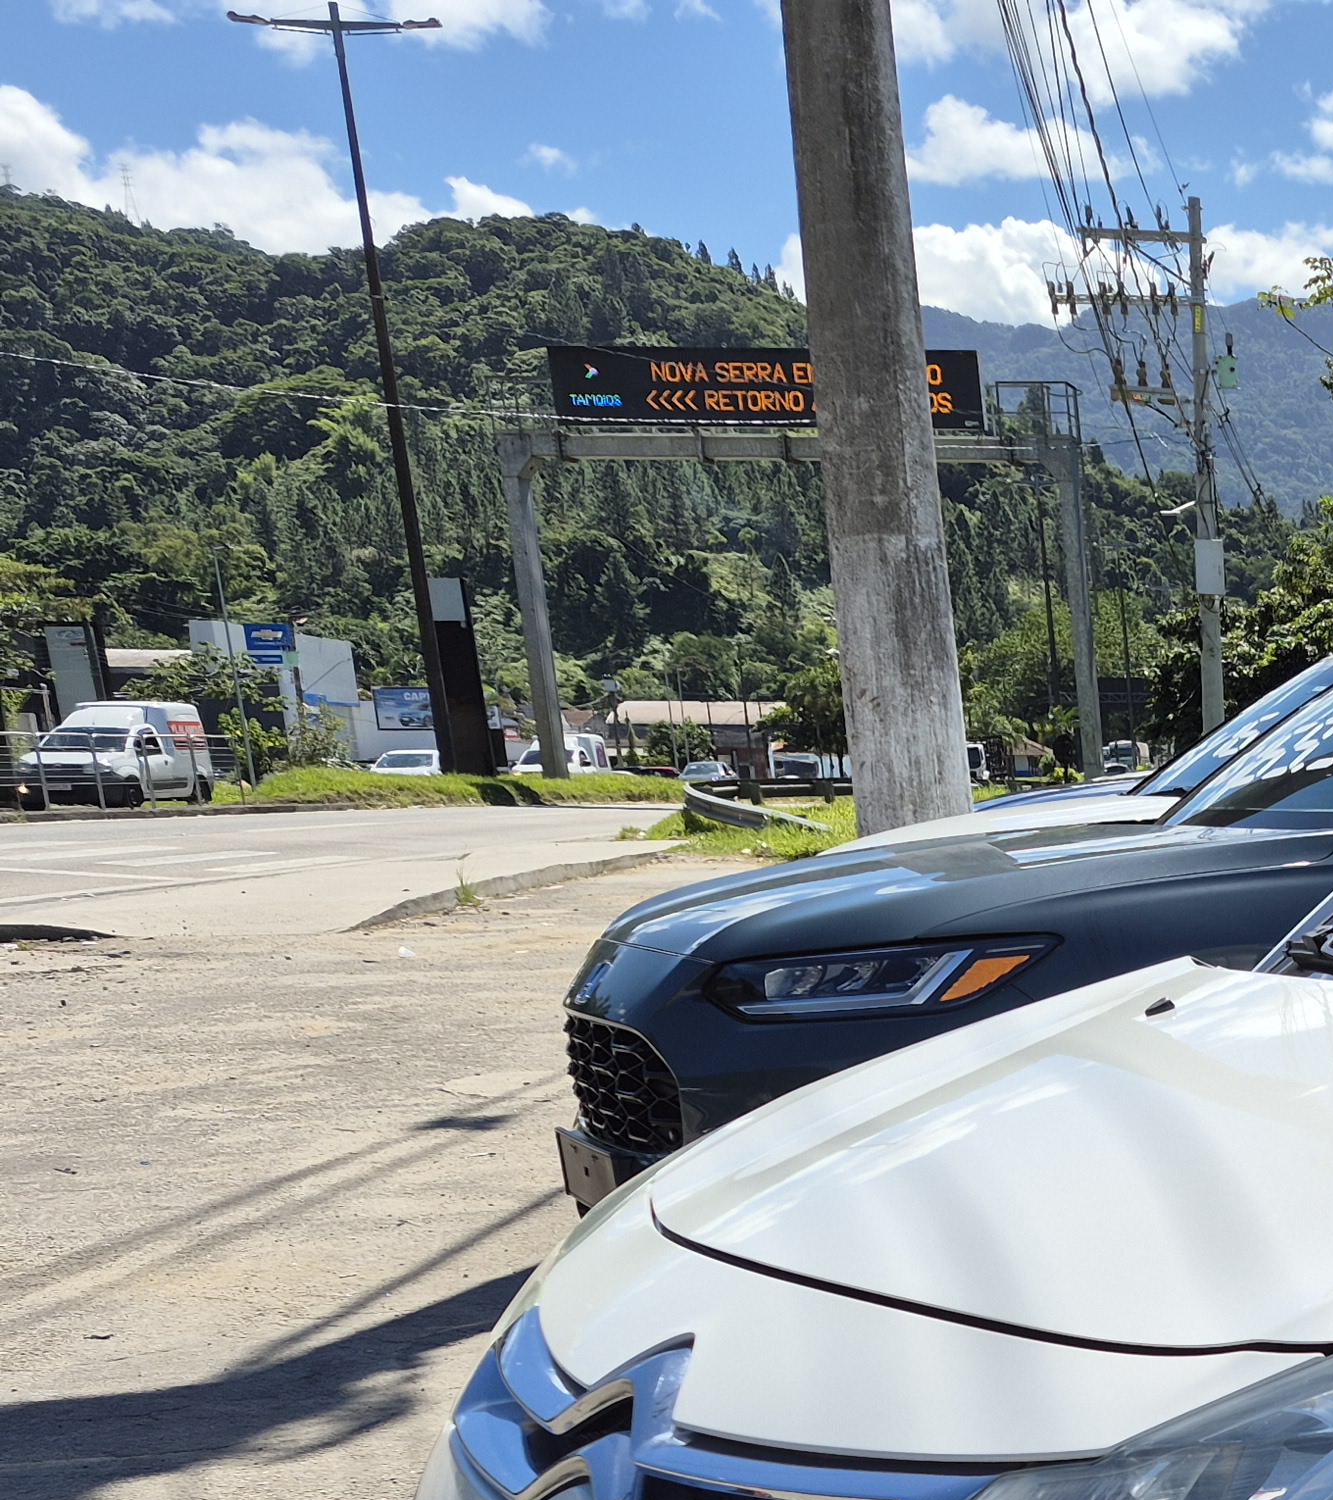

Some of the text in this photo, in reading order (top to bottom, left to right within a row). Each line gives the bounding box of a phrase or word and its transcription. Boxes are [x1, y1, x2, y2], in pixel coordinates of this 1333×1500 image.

[650, 361, 710, 383] NOVA
[715, 361, 789, 384] SERRA
[704, 390, 806, 412] RETORNO
